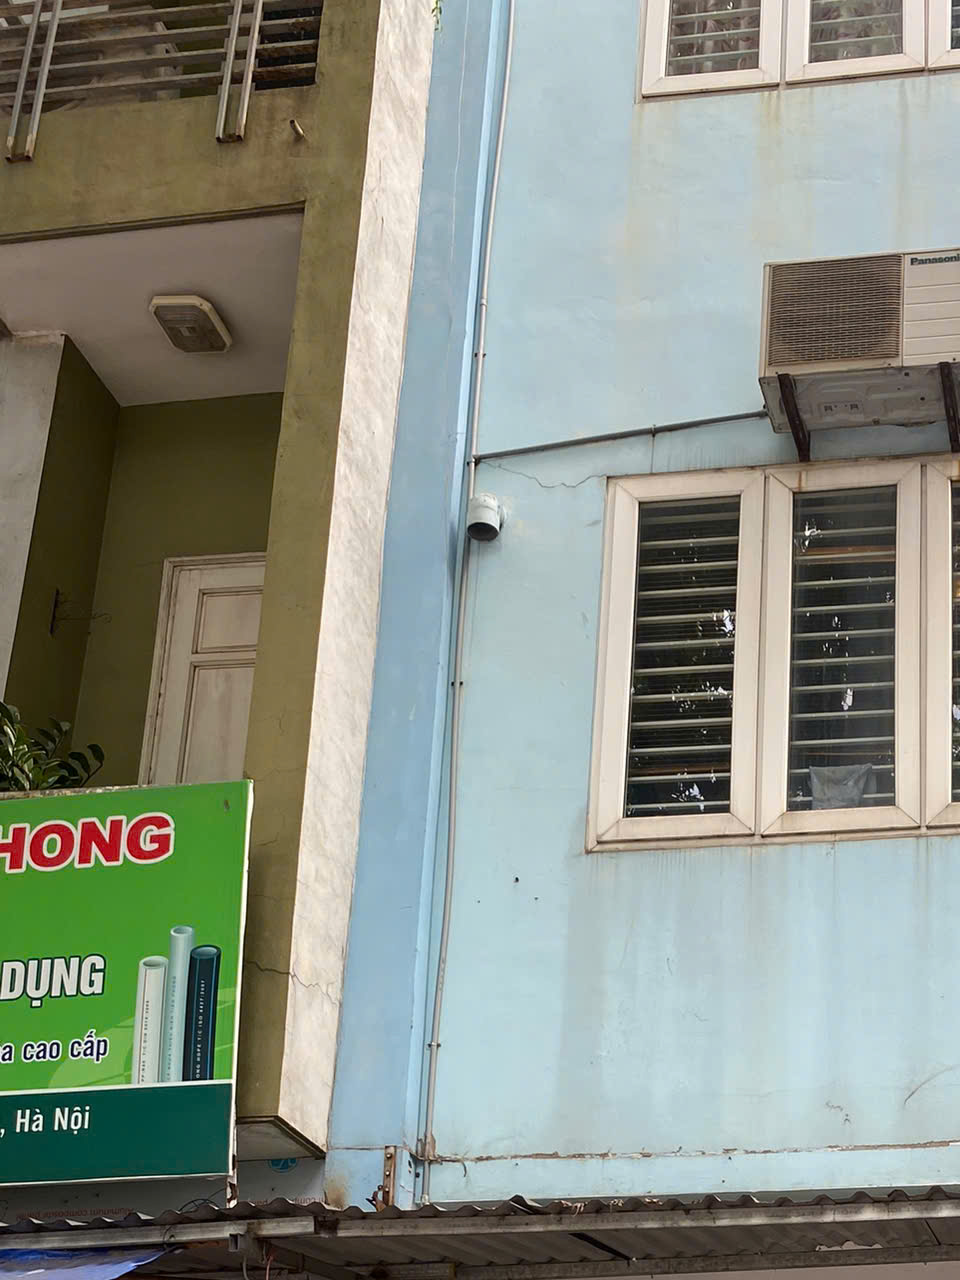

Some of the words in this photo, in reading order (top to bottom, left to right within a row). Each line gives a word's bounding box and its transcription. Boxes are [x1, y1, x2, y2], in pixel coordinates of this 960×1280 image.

[0, 813, 174, 873] HONG
[0, 954, 106, 1008] DỤNG
[22, 1041, 61, 1062] cao
[69, 1029, 109, 1064] cấp
[15, 1108, 44, 1133] Hà
[53, 1105, 91, 1135] Nội
